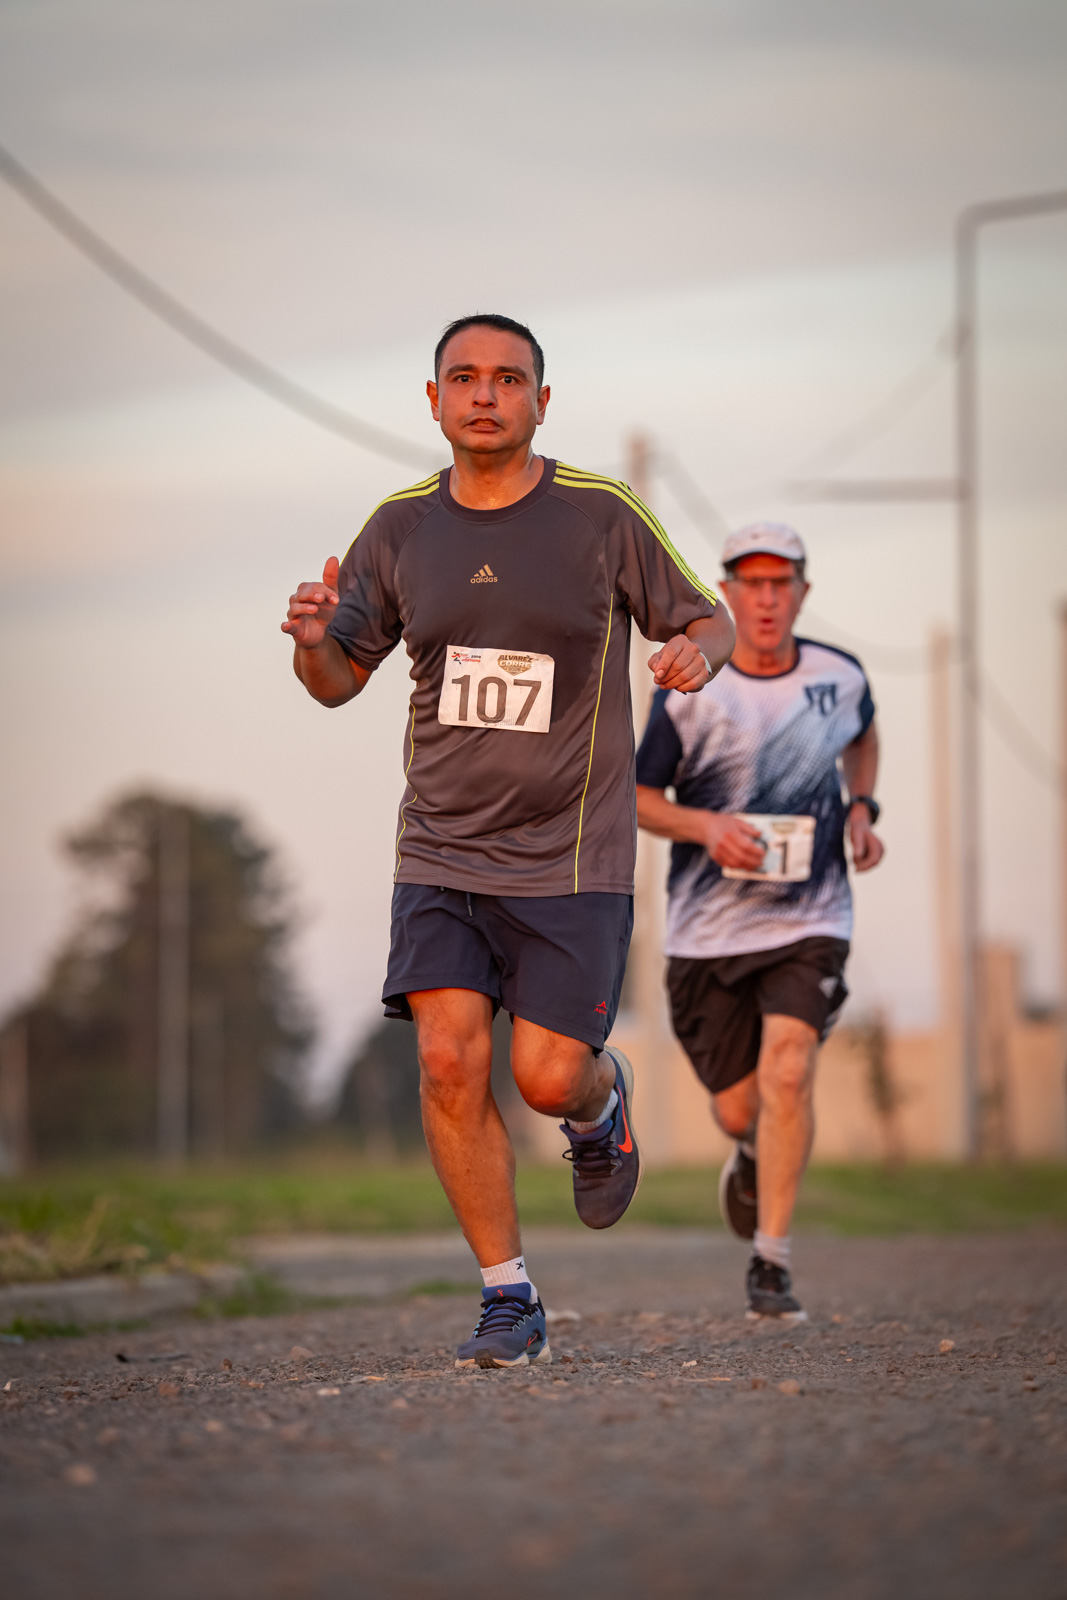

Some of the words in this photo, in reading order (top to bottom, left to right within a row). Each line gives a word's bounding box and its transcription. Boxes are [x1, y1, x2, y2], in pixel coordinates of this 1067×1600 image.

[470, 576, 498, 584] adidas
[499, 660, 532, 668] CORRE
[452, 674, 542, 726] 107
